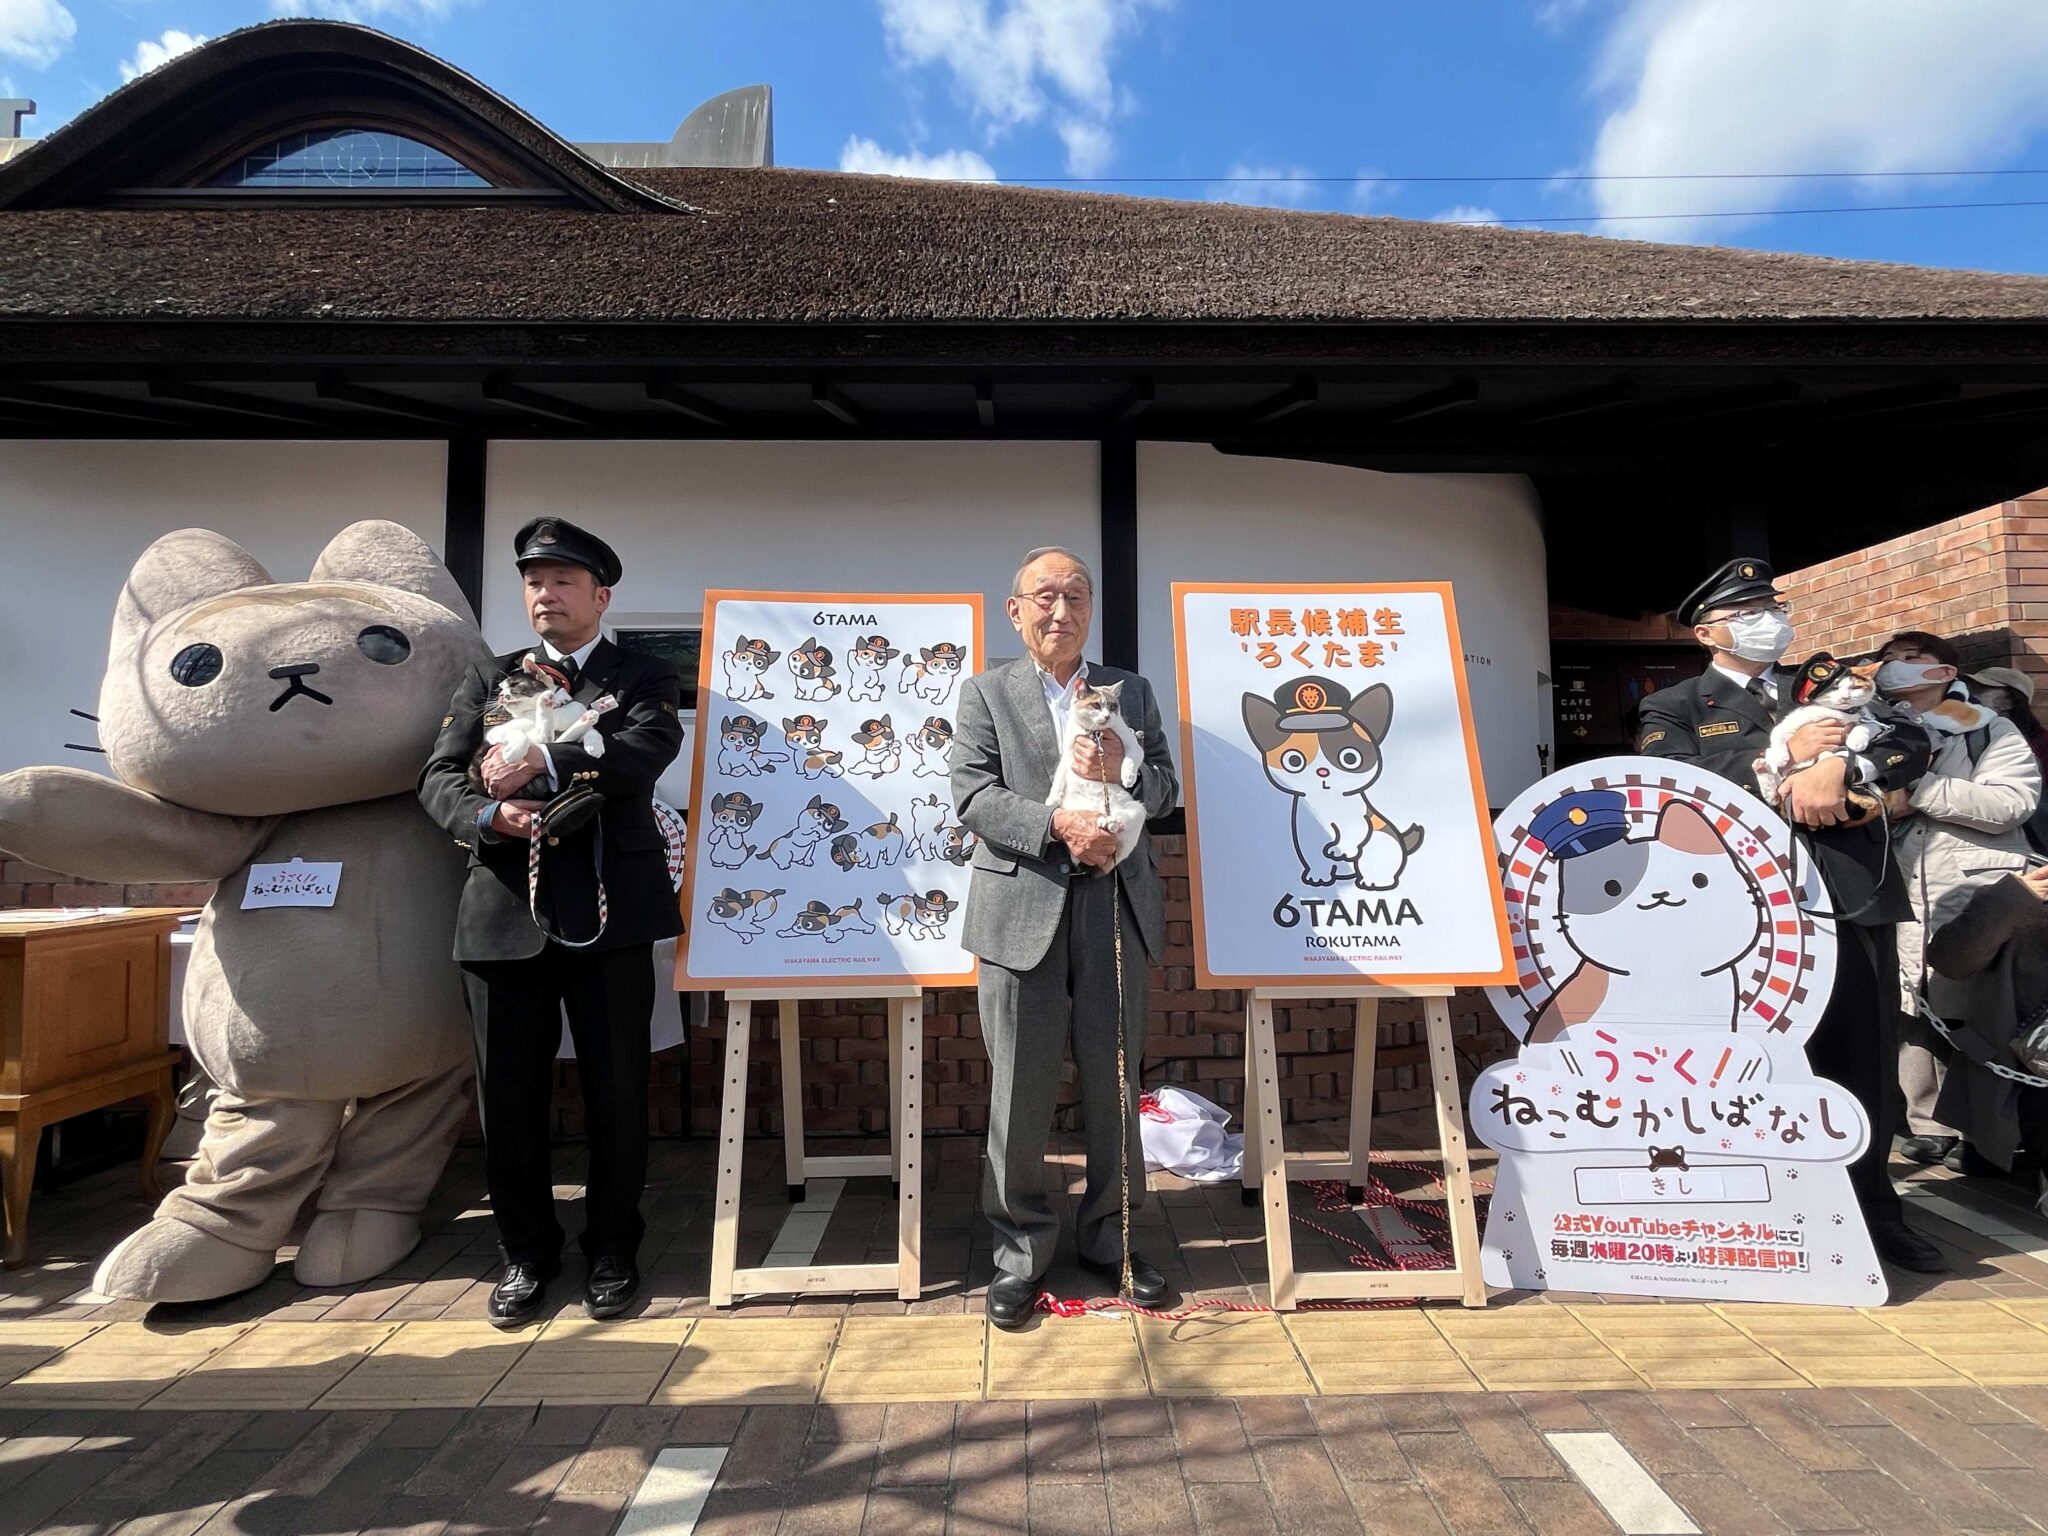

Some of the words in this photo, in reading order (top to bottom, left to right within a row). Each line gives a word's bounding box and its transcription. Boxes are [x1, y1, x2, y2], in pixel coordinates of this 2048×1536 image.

[813, 611, 878, 626] 6TAMA
[1230, 607, 1405, 636] 駅長候補生
[1560, 698, 1592, 706] CAFE
[1561, 713, 1593, 721] SHOP
[251, 884, 333, 897] ねこむかしばなし
[1273, 893, 1424, 928] 6TAMA
[1305, 935, 1401, 948] ROKUTAMA
[1489, 1083, 1847, 1144] ねこむかしばなし
[1652, 1176, 1693, 1196] きし
[1553, 1214, 1800, 1243] 公式YouTubeチャンネルにて
